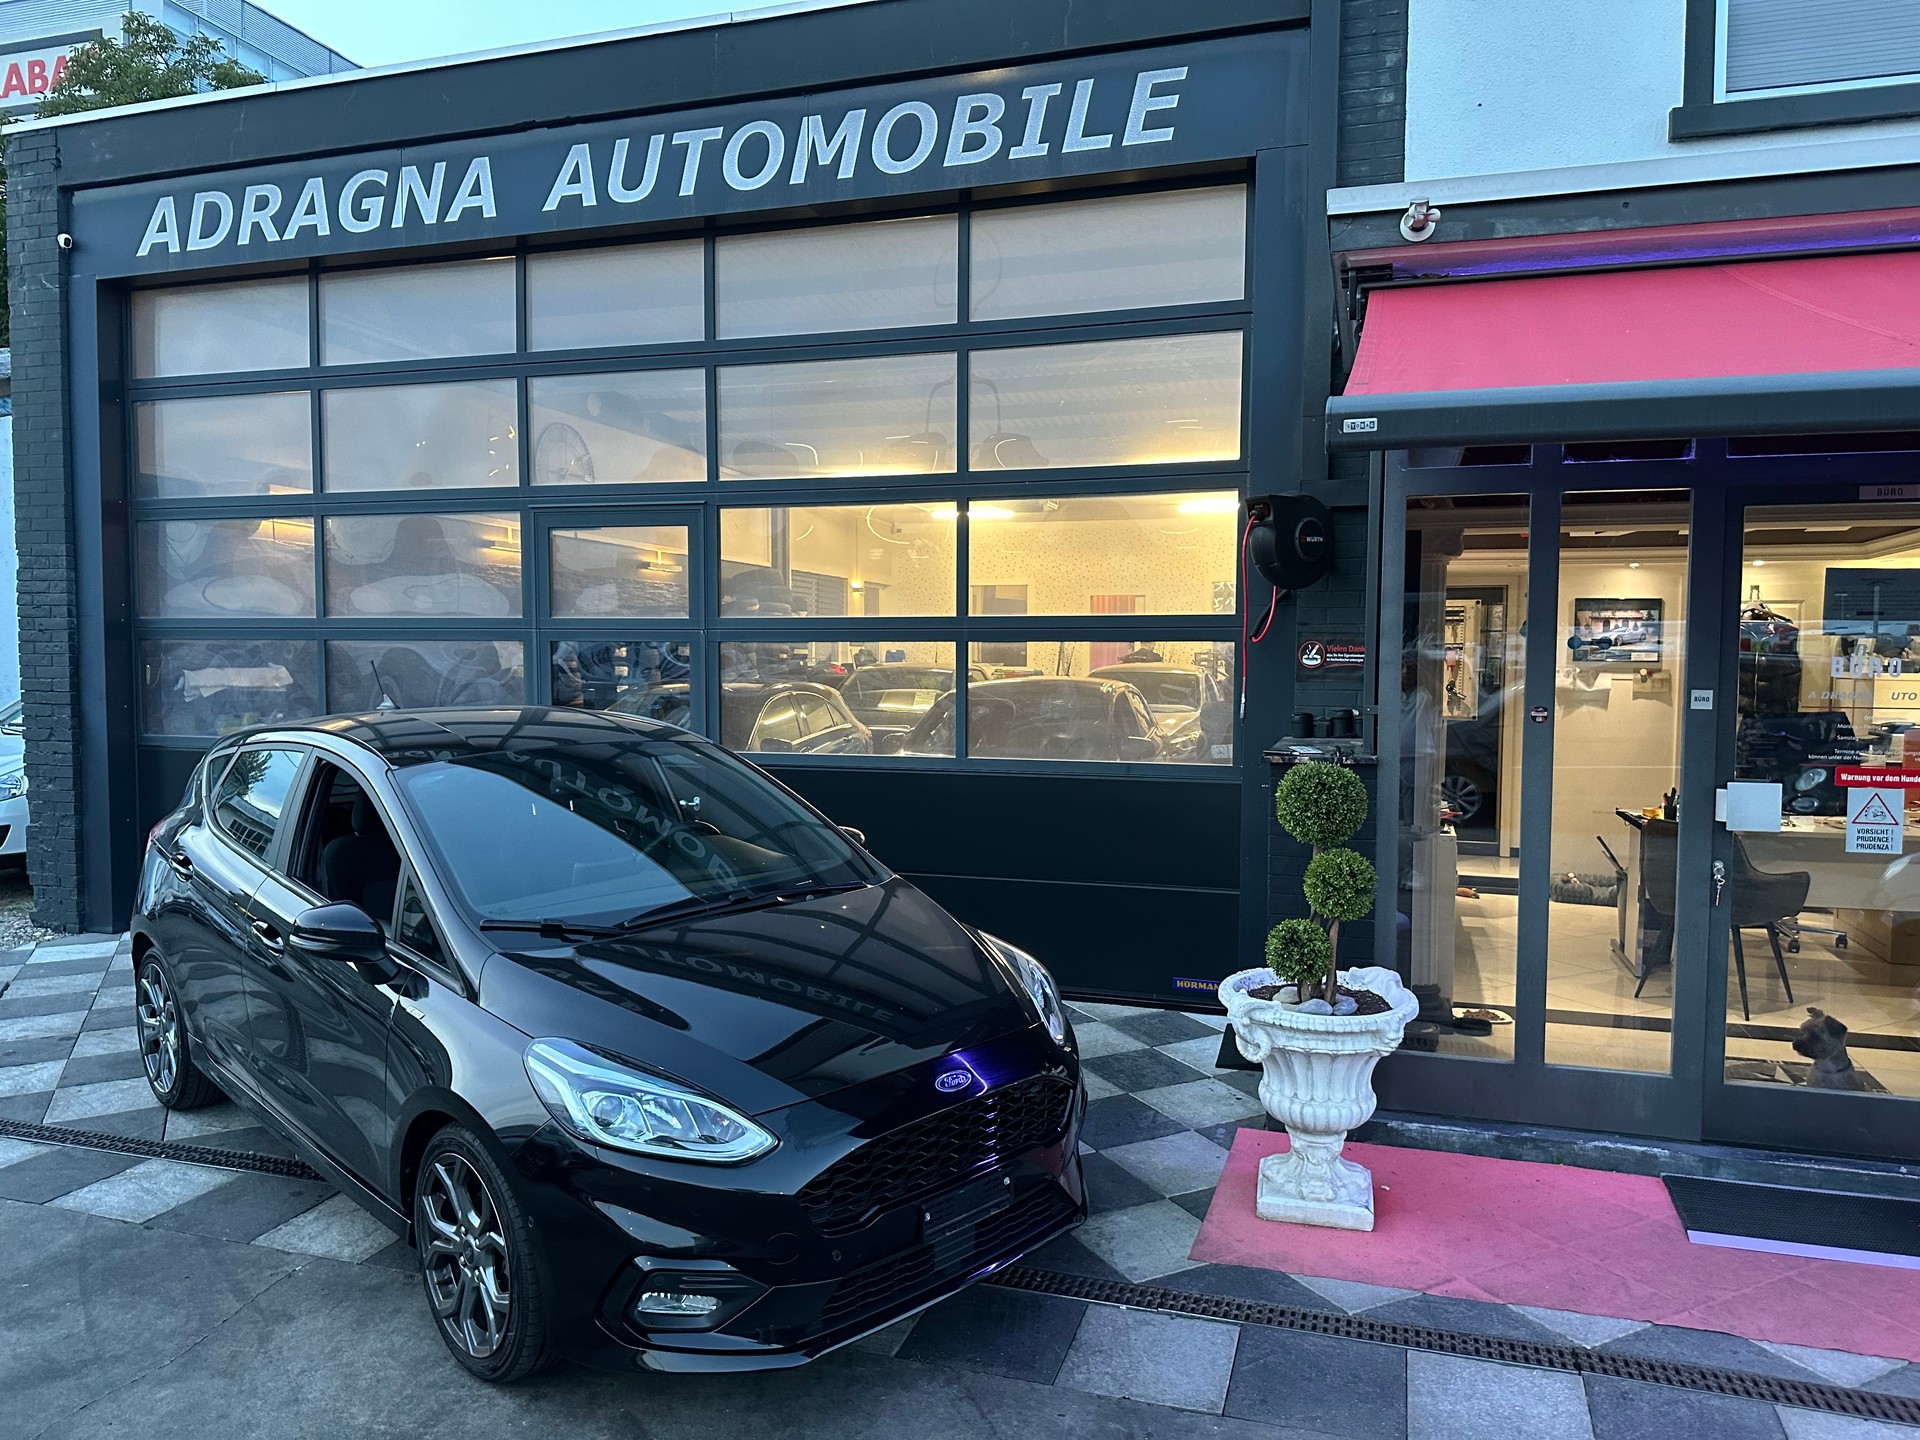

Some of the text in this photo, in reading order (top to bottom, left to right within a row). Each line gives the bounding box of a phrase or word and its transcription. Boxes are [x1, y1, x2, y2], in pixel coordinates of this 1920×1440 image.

[136, 66, 1189, 257] ADRAGNA AUTOMOBILE
[1841, 773, 1870, 782] Warnung
